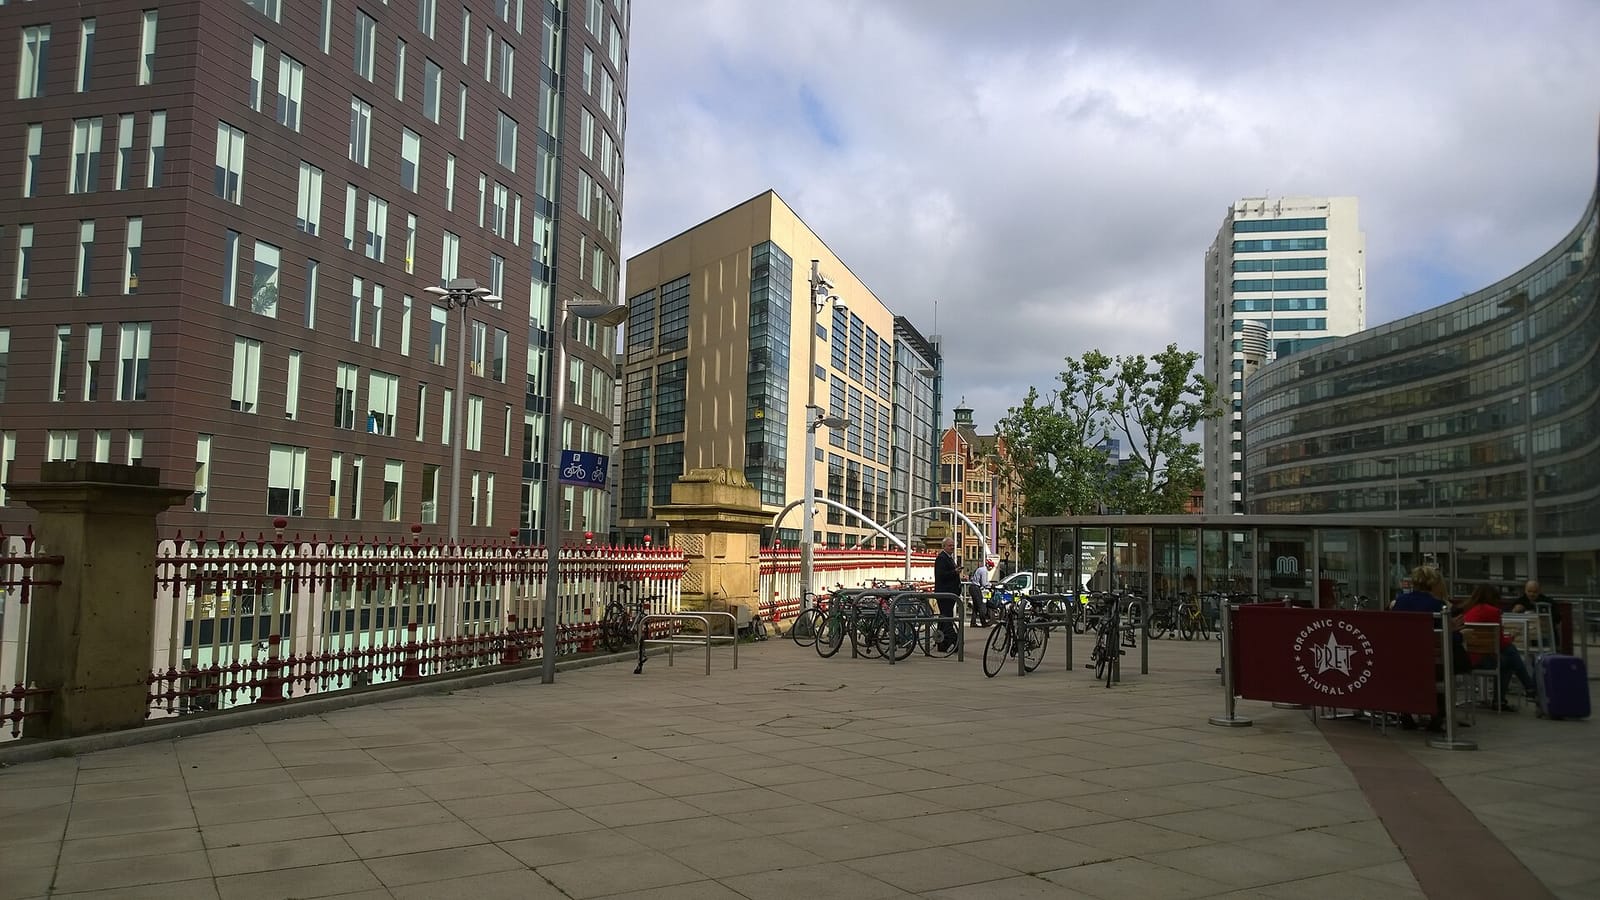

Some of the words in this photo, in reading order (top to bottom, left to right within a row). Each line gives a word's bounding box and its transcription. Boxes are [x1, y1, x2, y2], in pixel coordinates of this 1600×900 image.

[1294, 619, 1333, 651] ORGANIC
[1338, 621, 1374, 655] COFFEE
[1314, 643, 1353, 670] PRET
[1297, 666, 1345, 695] NATURAL
[1347, 670, 1371, 693] FOOD
